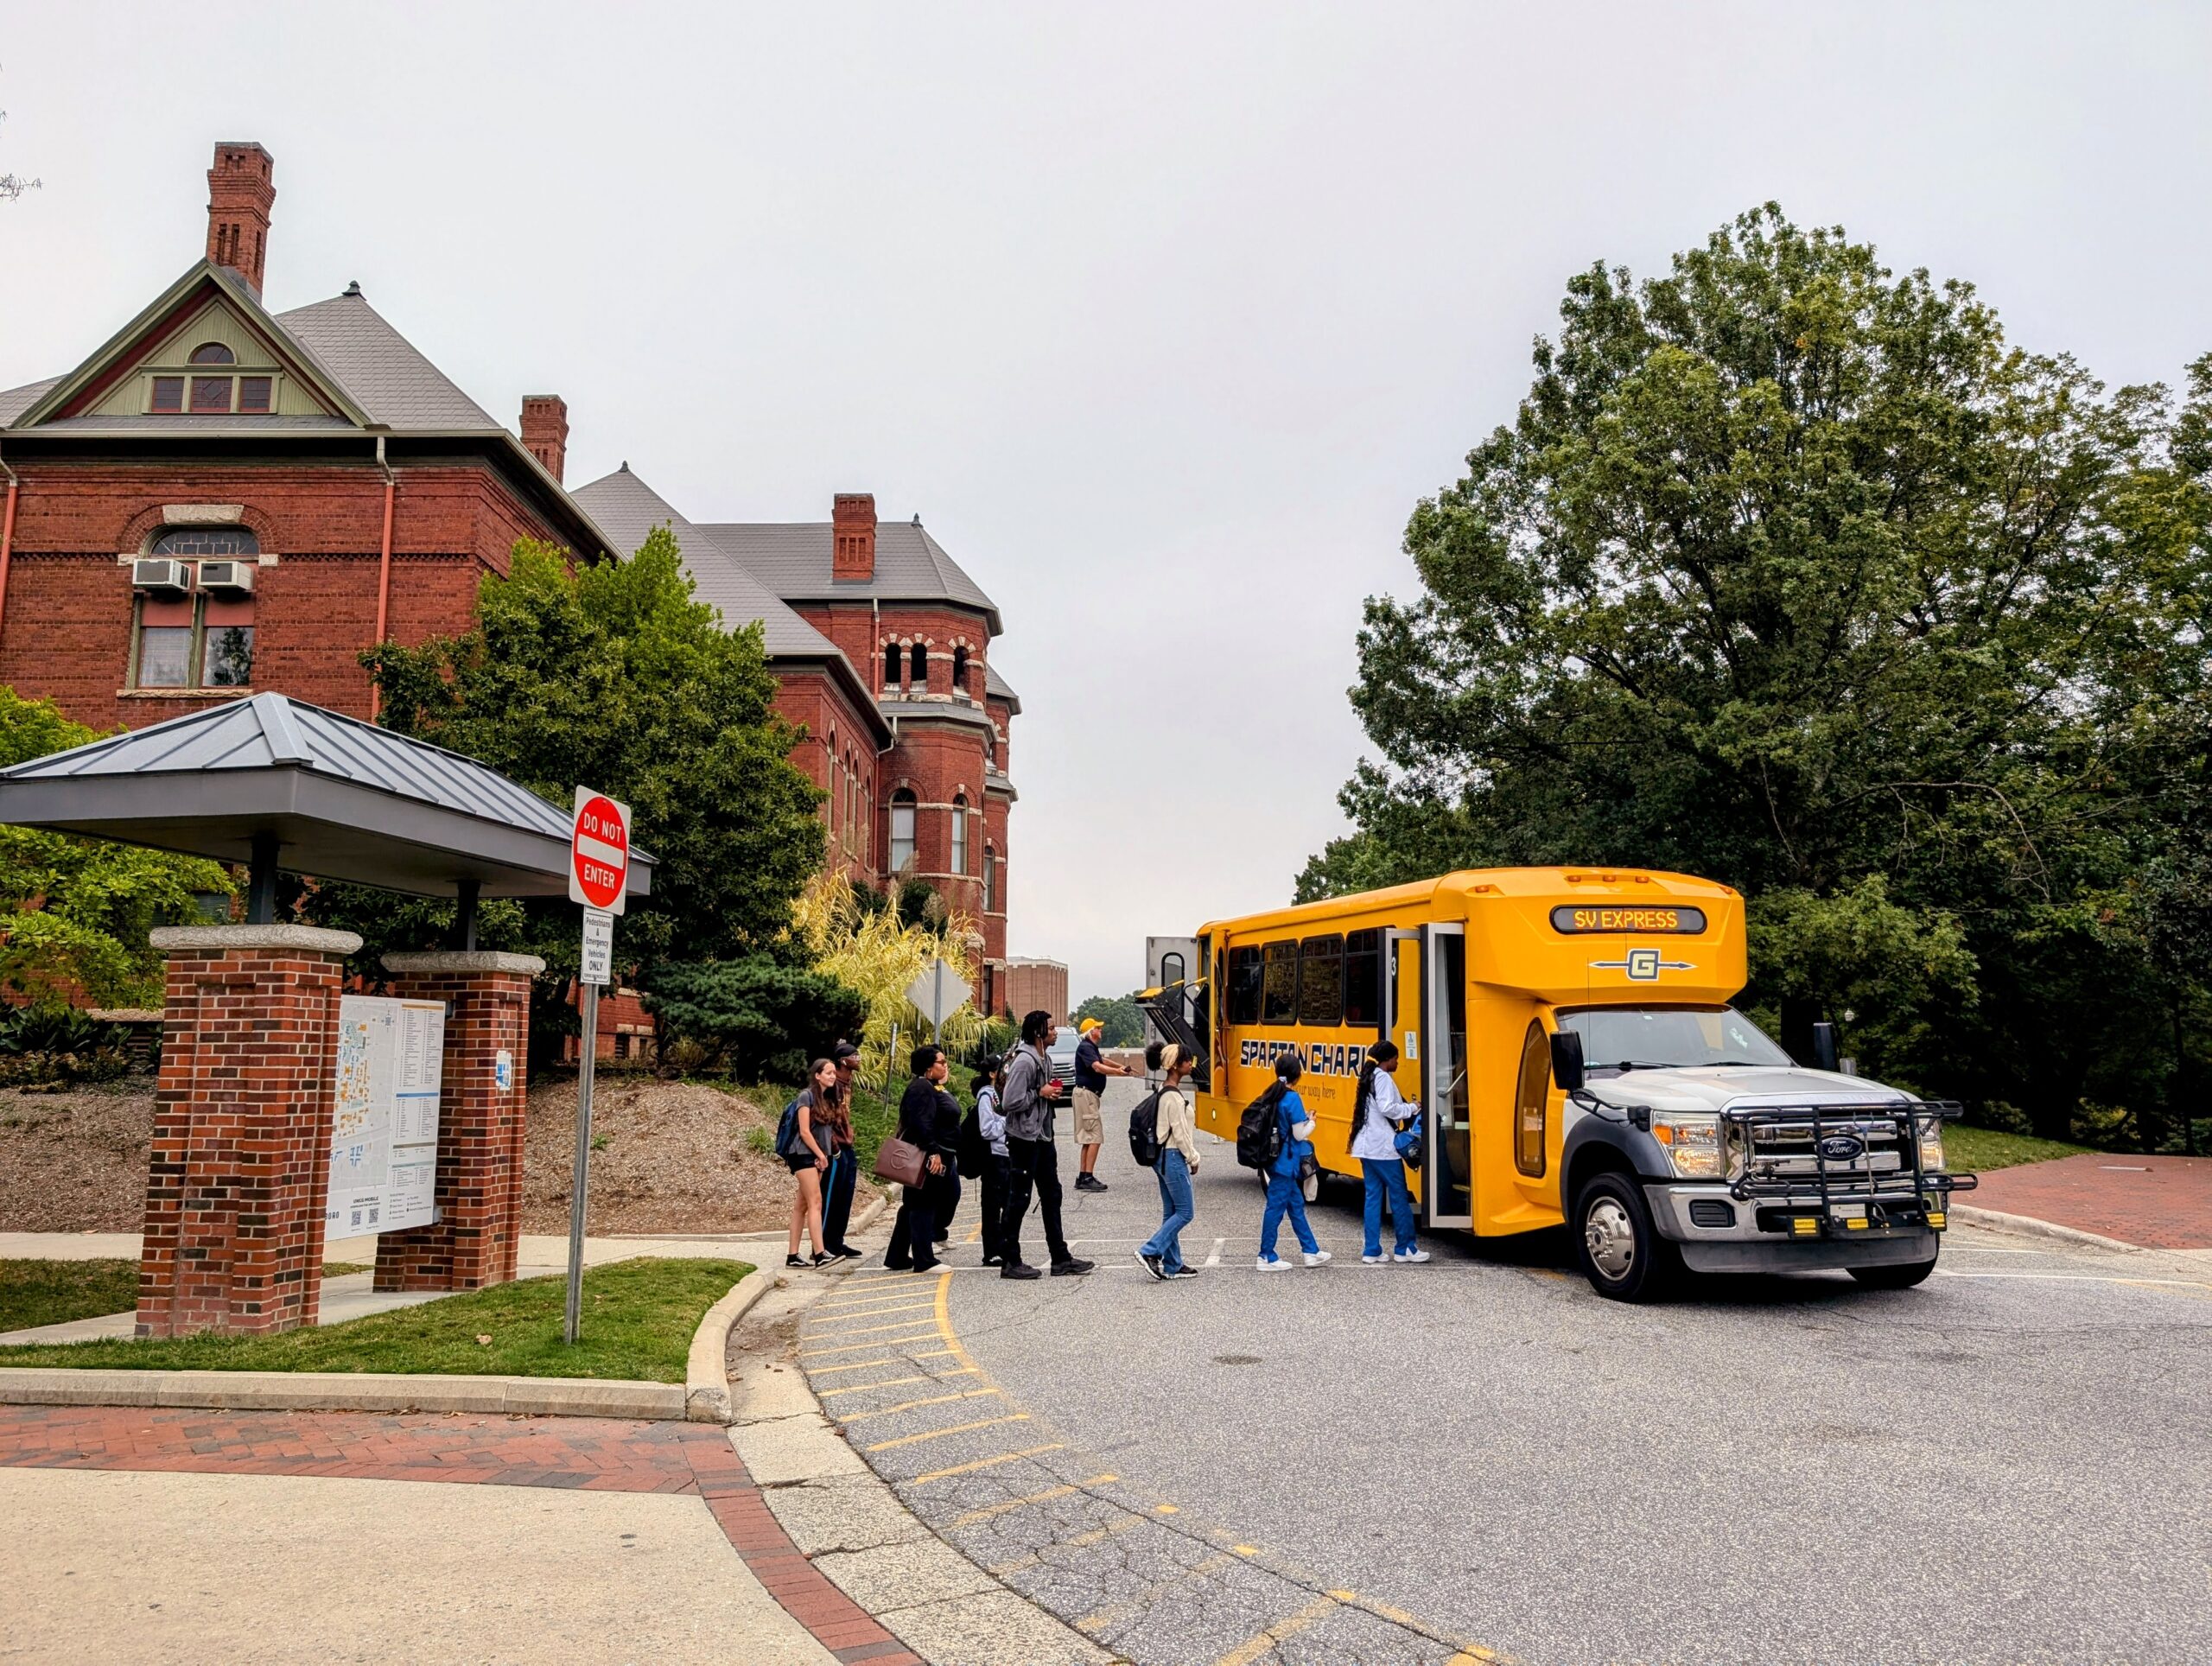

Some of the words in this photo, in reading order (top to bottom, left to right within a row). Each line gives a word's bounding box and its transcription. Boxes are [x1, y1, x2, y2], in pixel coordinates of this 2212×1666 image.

[583, 812, 598, 833] DO
[601, 819, 622, 843] NOT
[584, 863, 615, 889] ENTER
[586, 917, 611, 928] Pedestrians
[1574, 911, 1597, 927] SV
[1601, 911, 1678, 928] EXPRESS
[586, 936, 609, 949] Emergency
[588, 949, 606, 958] Vehicles
[588, 960, 603, 971] ONLY
[1626, 949, 1661, 981] G
[1307, 1086, 1321, 1102] way
[1322, 1081, 1336, 1099] here
[1827, 1141, 1853, 1154] Ford
